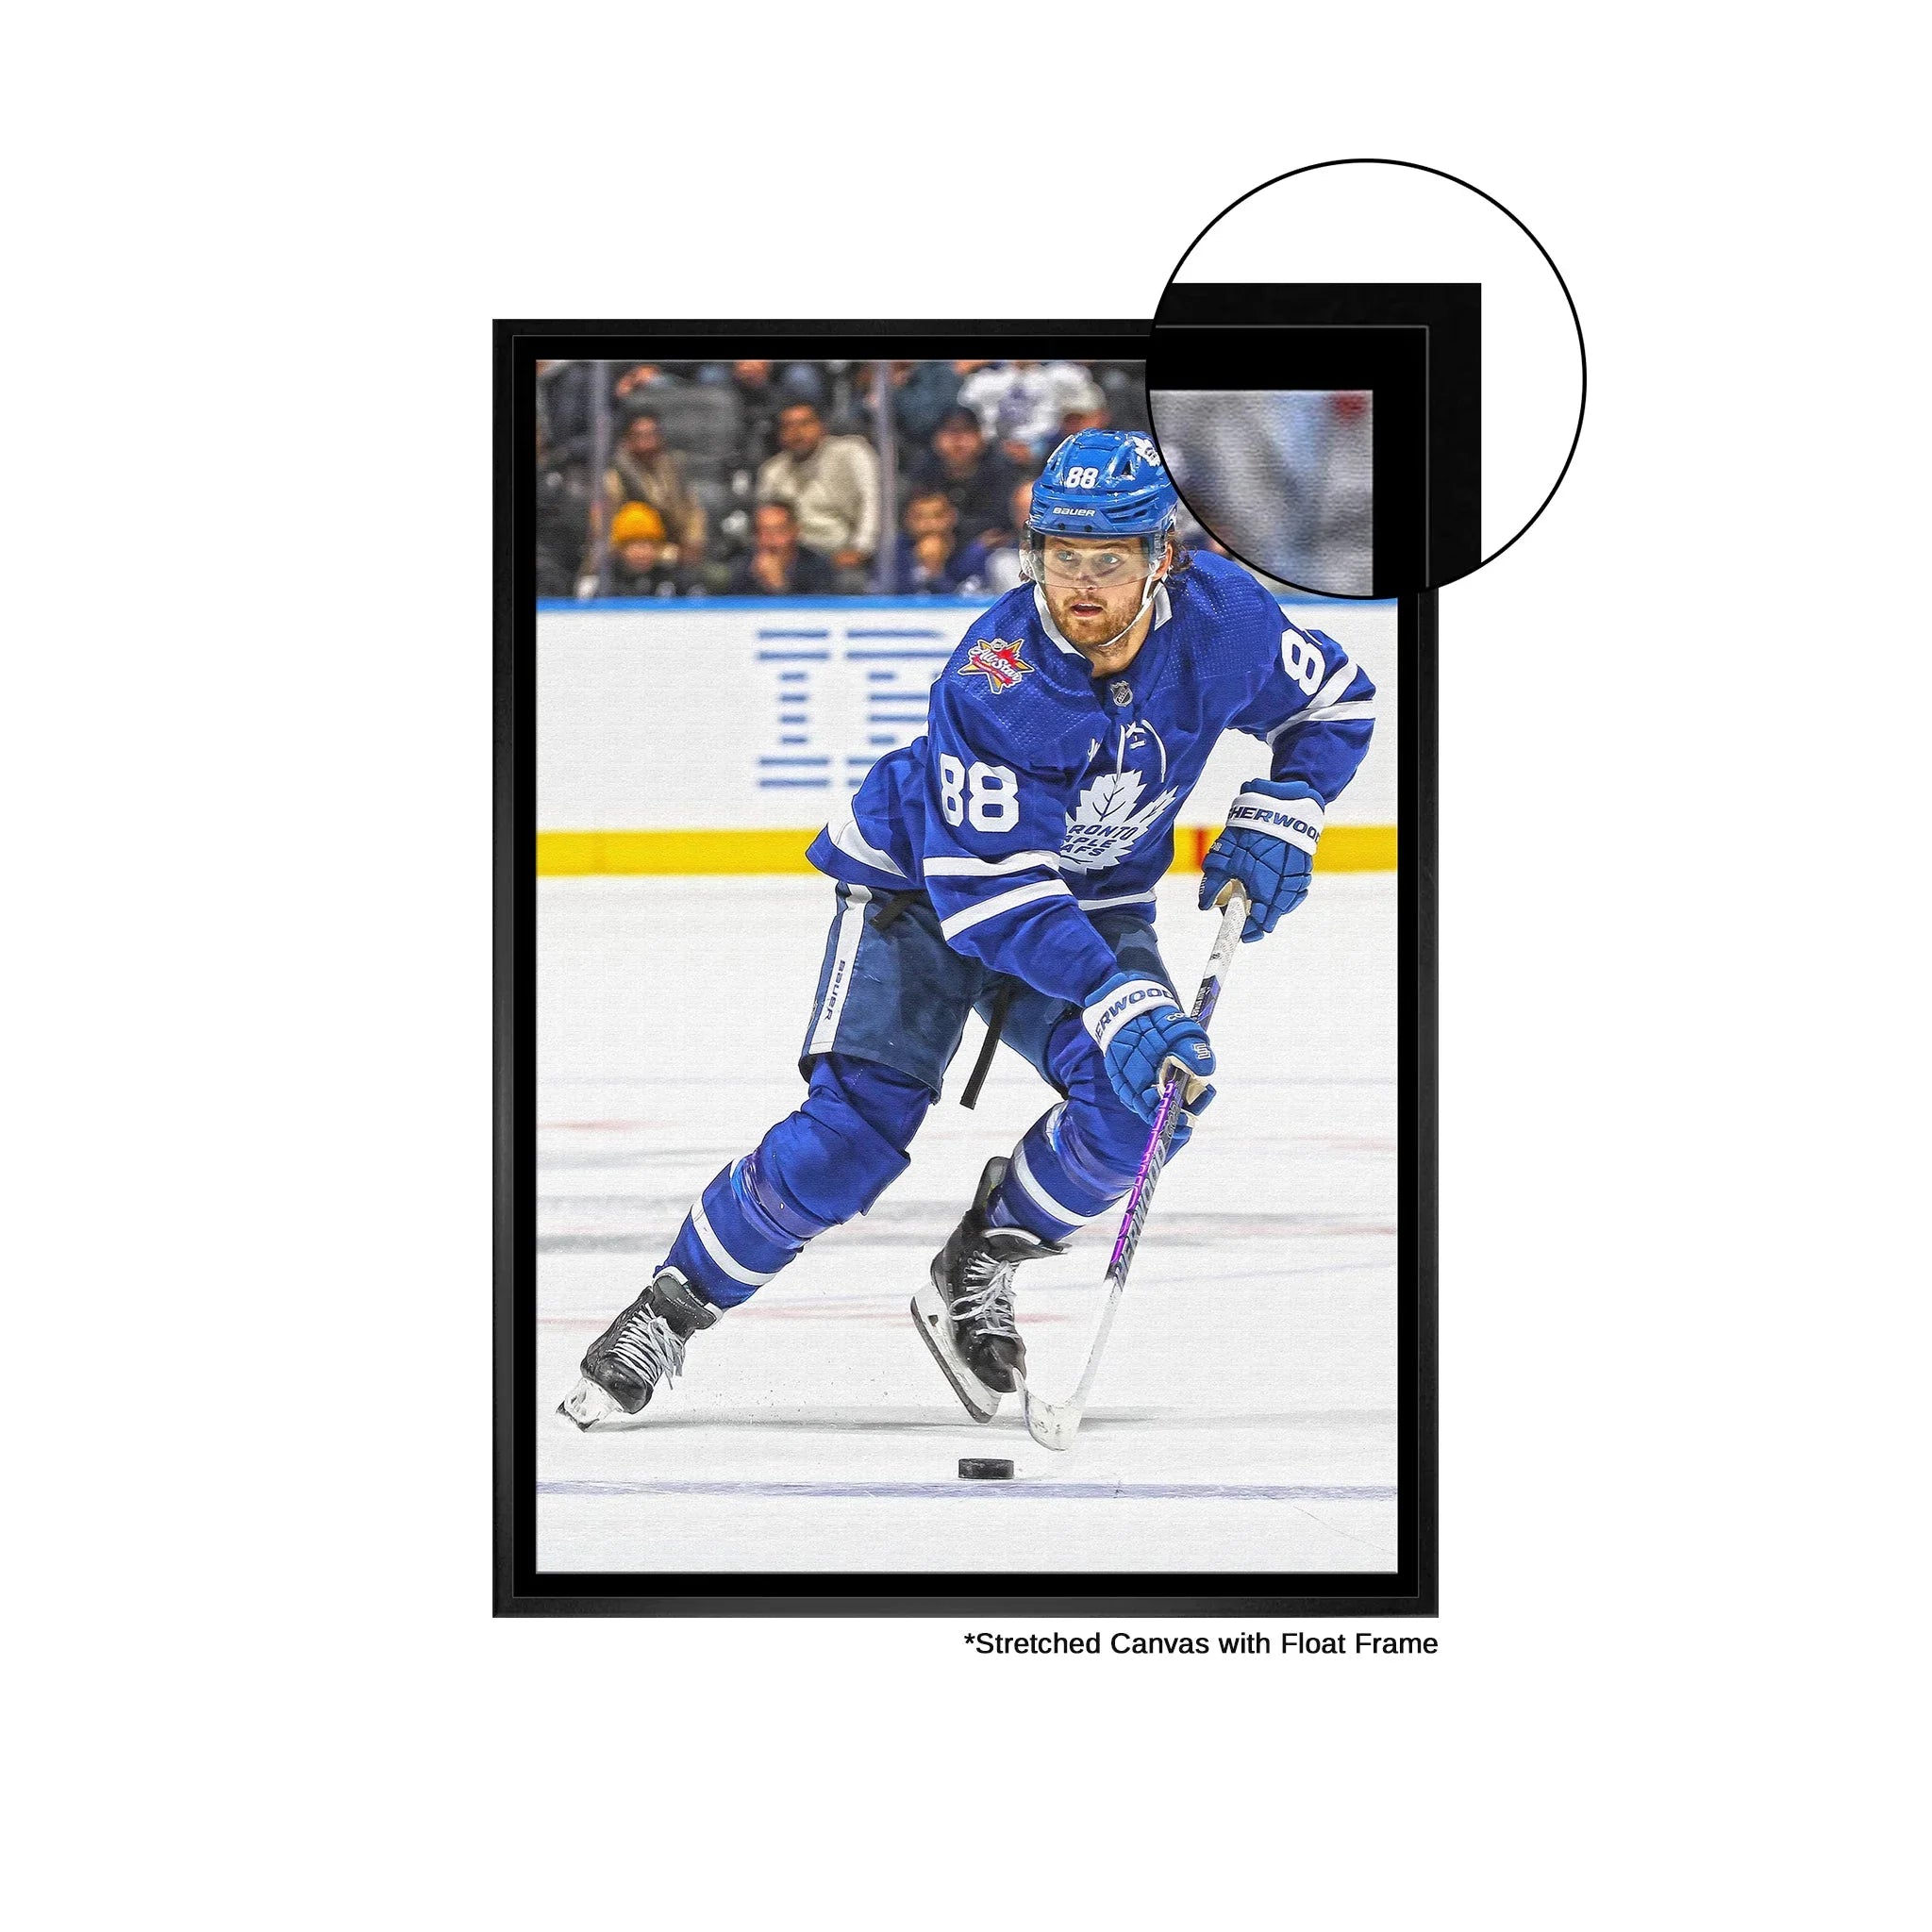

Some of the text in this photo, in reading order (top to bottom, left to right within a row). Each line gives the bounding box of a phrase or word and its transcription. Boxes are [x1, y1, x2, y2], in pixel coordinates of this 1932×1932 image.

[1066, 466, 1099, 489] 88
[1281, 628, 1324, 696] 8
[758, 627, 953, 789] IB
[940, 753, 1019, 833] 88
[1068, 824, 1139, 841] RONTO
[1228, 806, 1321, 843] HERWOO
[1059, 844, 1106, 856] AFS
[1064, 835, 1117, 848] APLE
